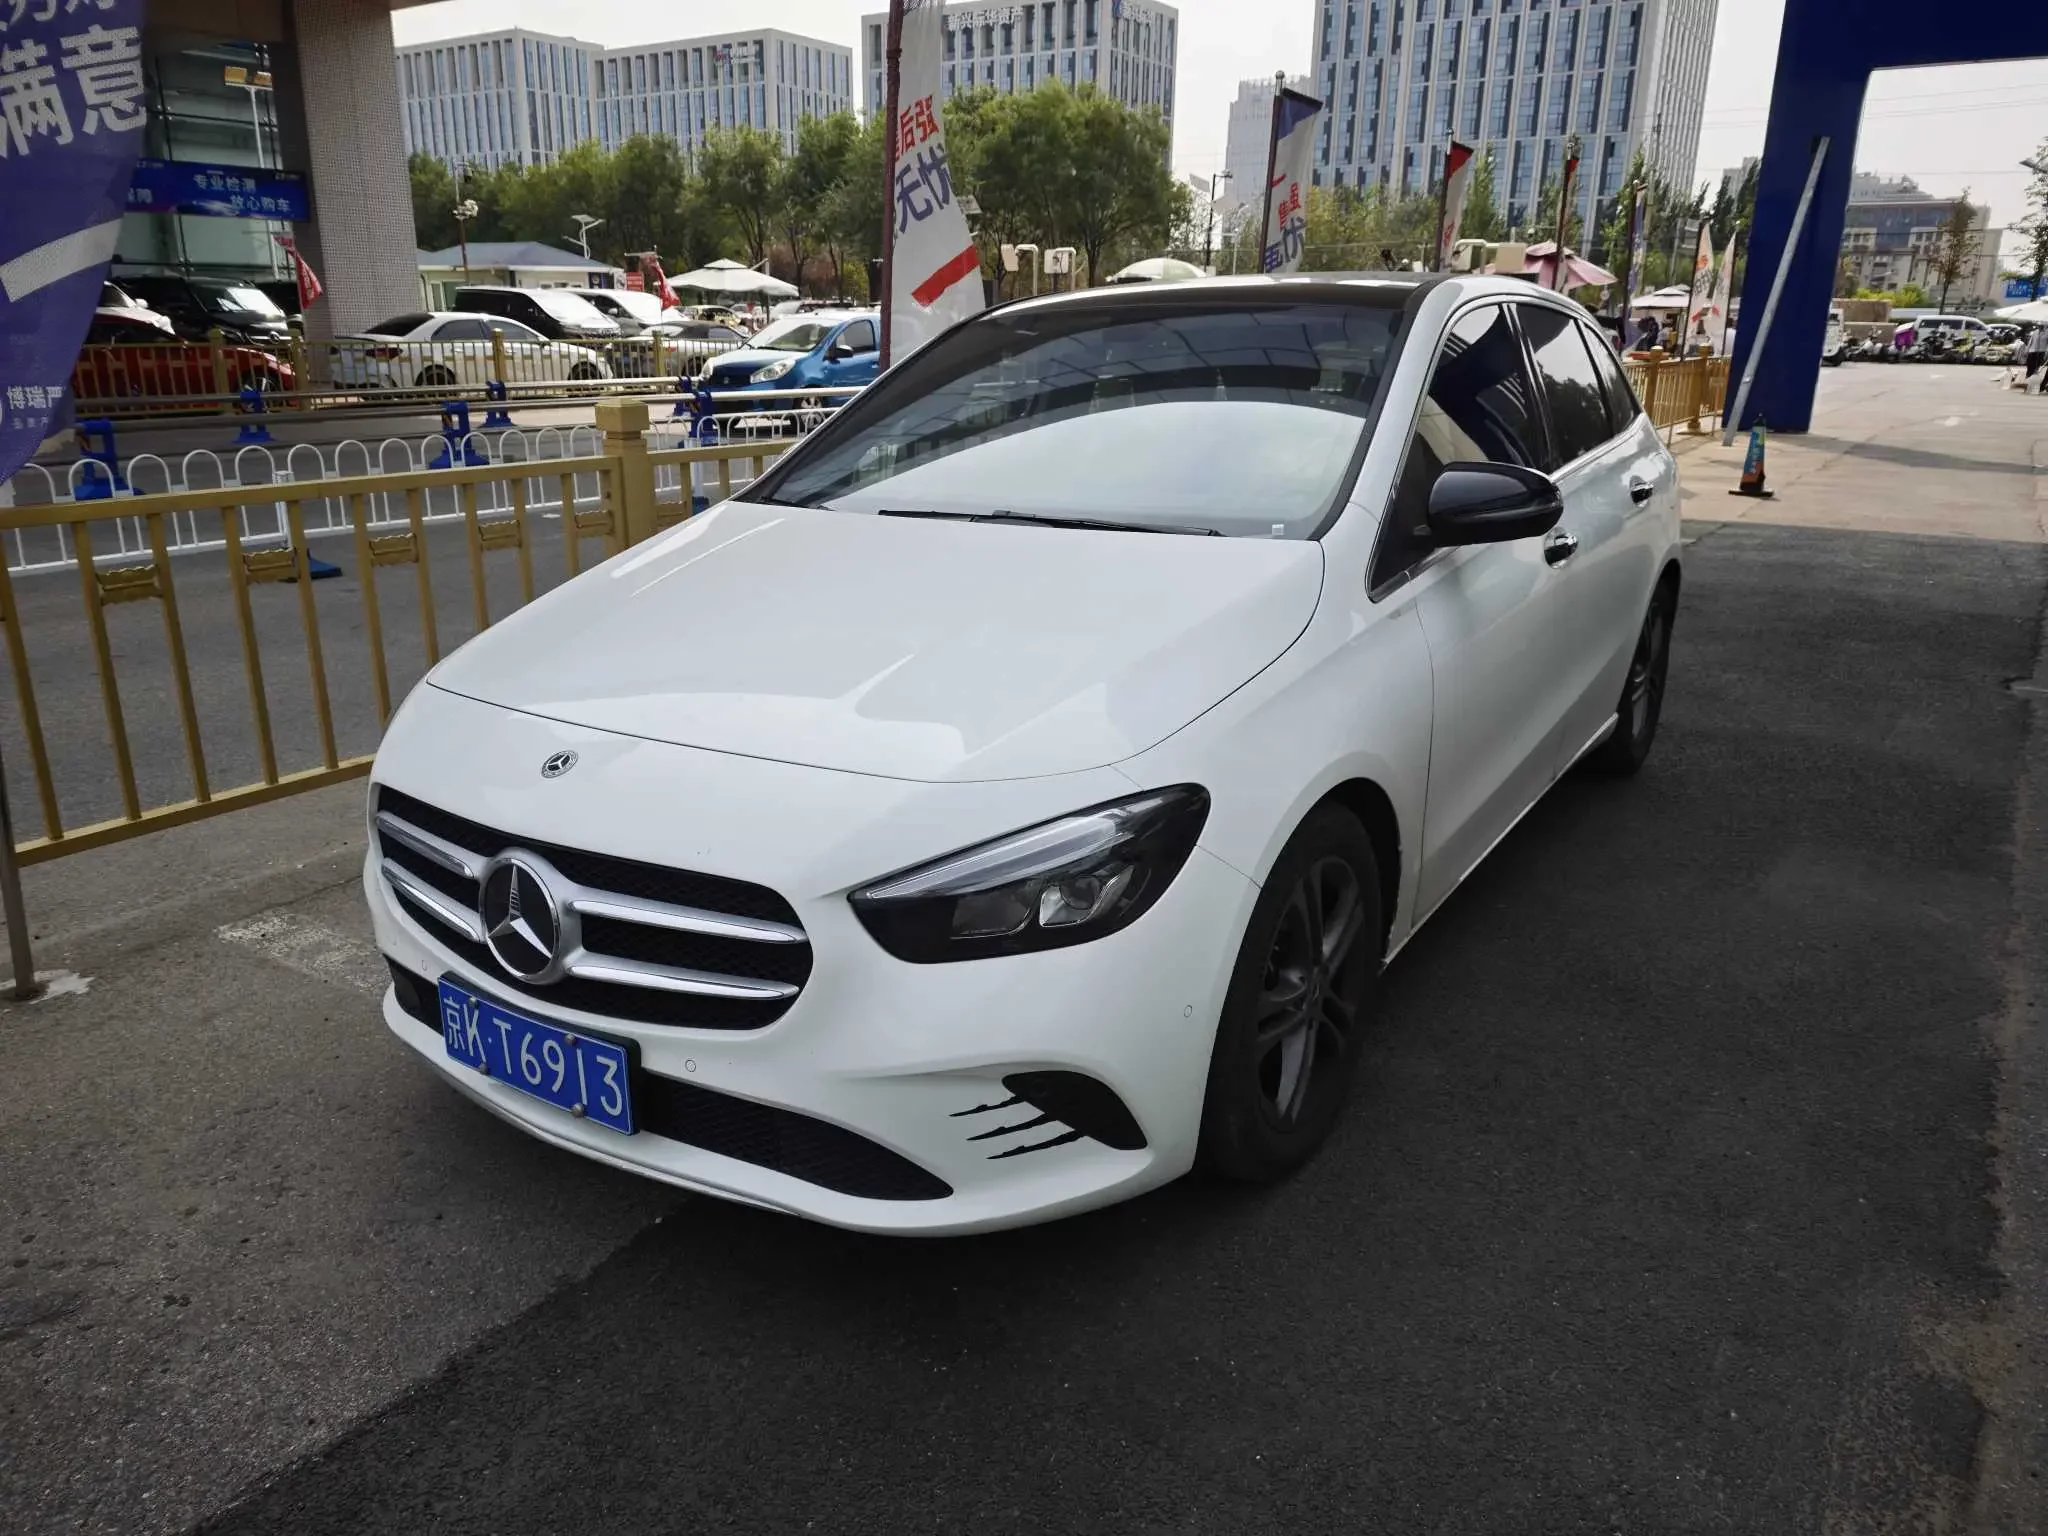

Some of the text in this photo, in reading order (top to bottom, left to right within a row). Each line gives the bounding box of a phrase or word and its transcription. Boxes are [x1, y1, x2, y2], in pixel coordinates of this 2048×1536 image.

[948, 6, 1024, 32] 新兴际华资产
[0, 23, 148, 159] 满意
[192, 171, 258, 194] 专业检测
